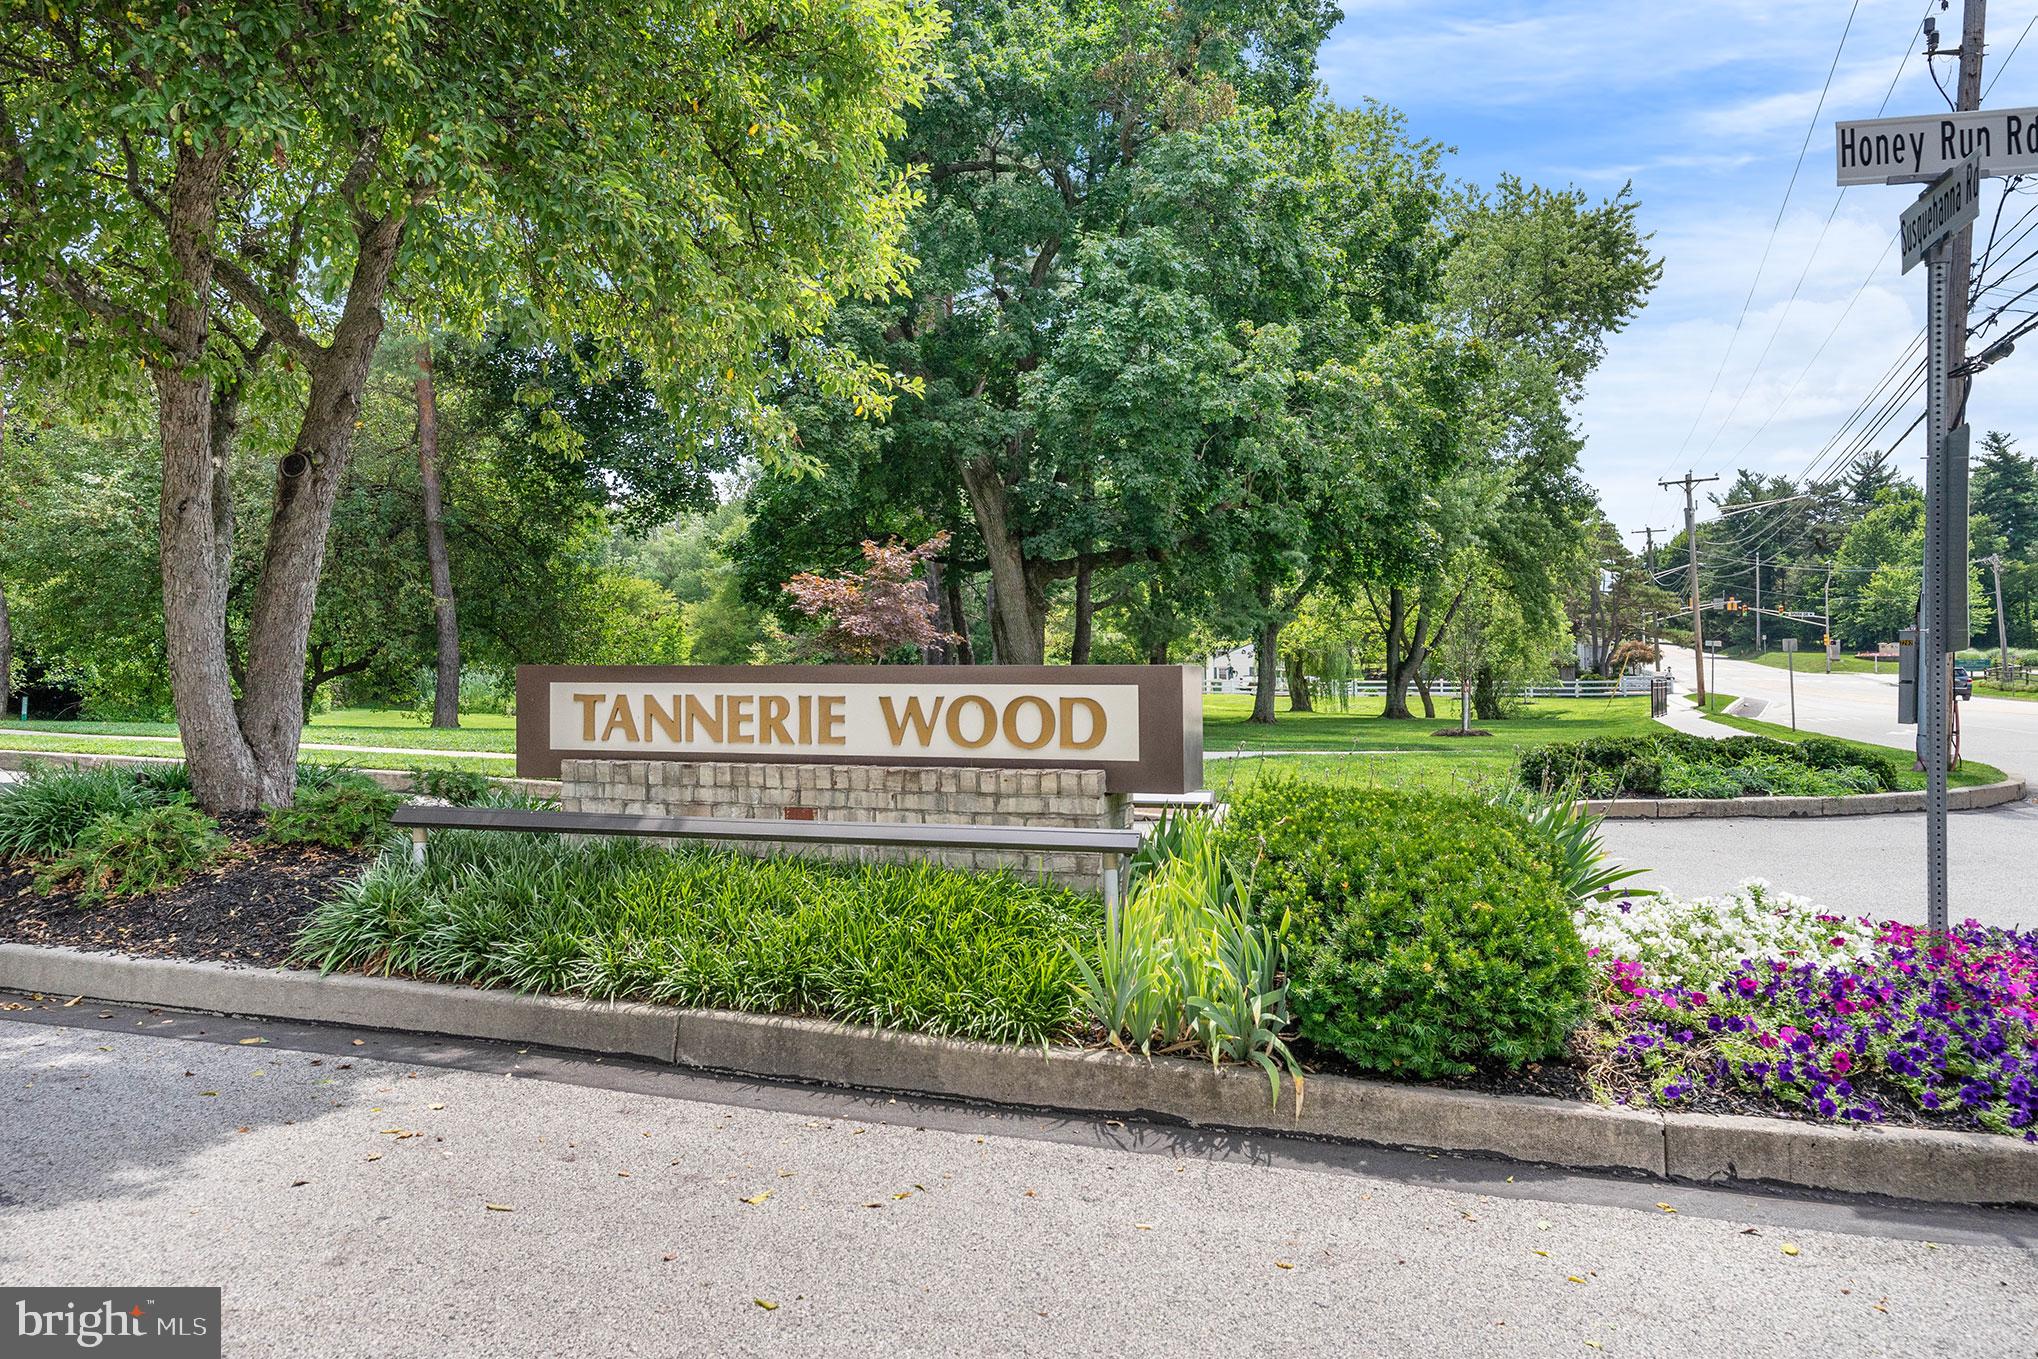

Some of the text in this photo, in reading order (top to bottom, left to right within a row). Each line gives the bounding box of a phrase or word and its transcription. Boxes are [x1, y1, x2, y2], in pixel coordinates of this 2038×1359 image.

[1841, 115, 2038, 173] Honey Run Rd
[1901, 156, 1980, 257] Susquehanna Rd
[573, 693, 1108, 750] TANNERIE WOOD
